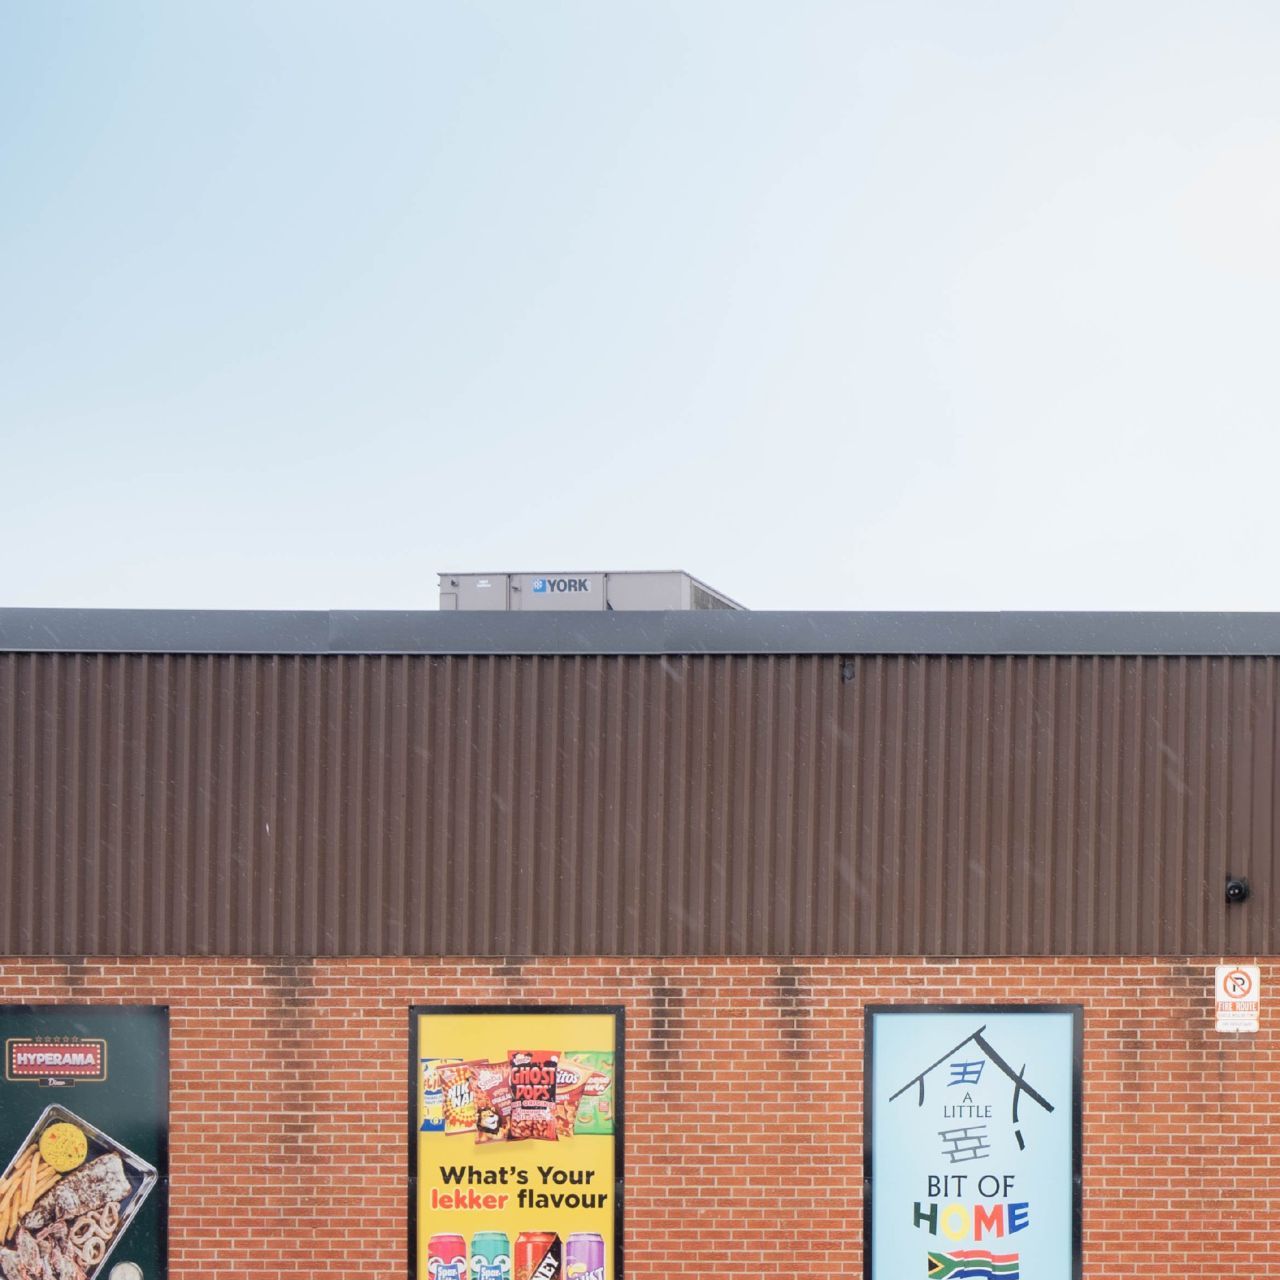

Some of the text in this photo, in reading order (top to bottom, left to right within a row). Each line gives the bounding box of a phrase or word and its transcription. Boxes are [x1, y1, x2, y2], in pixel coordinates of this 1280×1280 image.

[547, 578, 588, 593] YORK
[1218, 1002, 1258, 1011] FIRE ROUTE
[16, 1053, 96, 1066] HYPERAMA
[511, 1067, 556, 1085] GHOST
[515, 1085, 550, 1101] POPS
[962, 1091, 973, 1103] A
[943, 1105, 993, 1118] LITTLE
[439, 1165, 595, 1185] What's Your
[927, 1174, 1015, 1198] BIT OF
[431, 1188, 608, 1210] lekker flavour
[913, 1201, 1029, 1241] HOME
